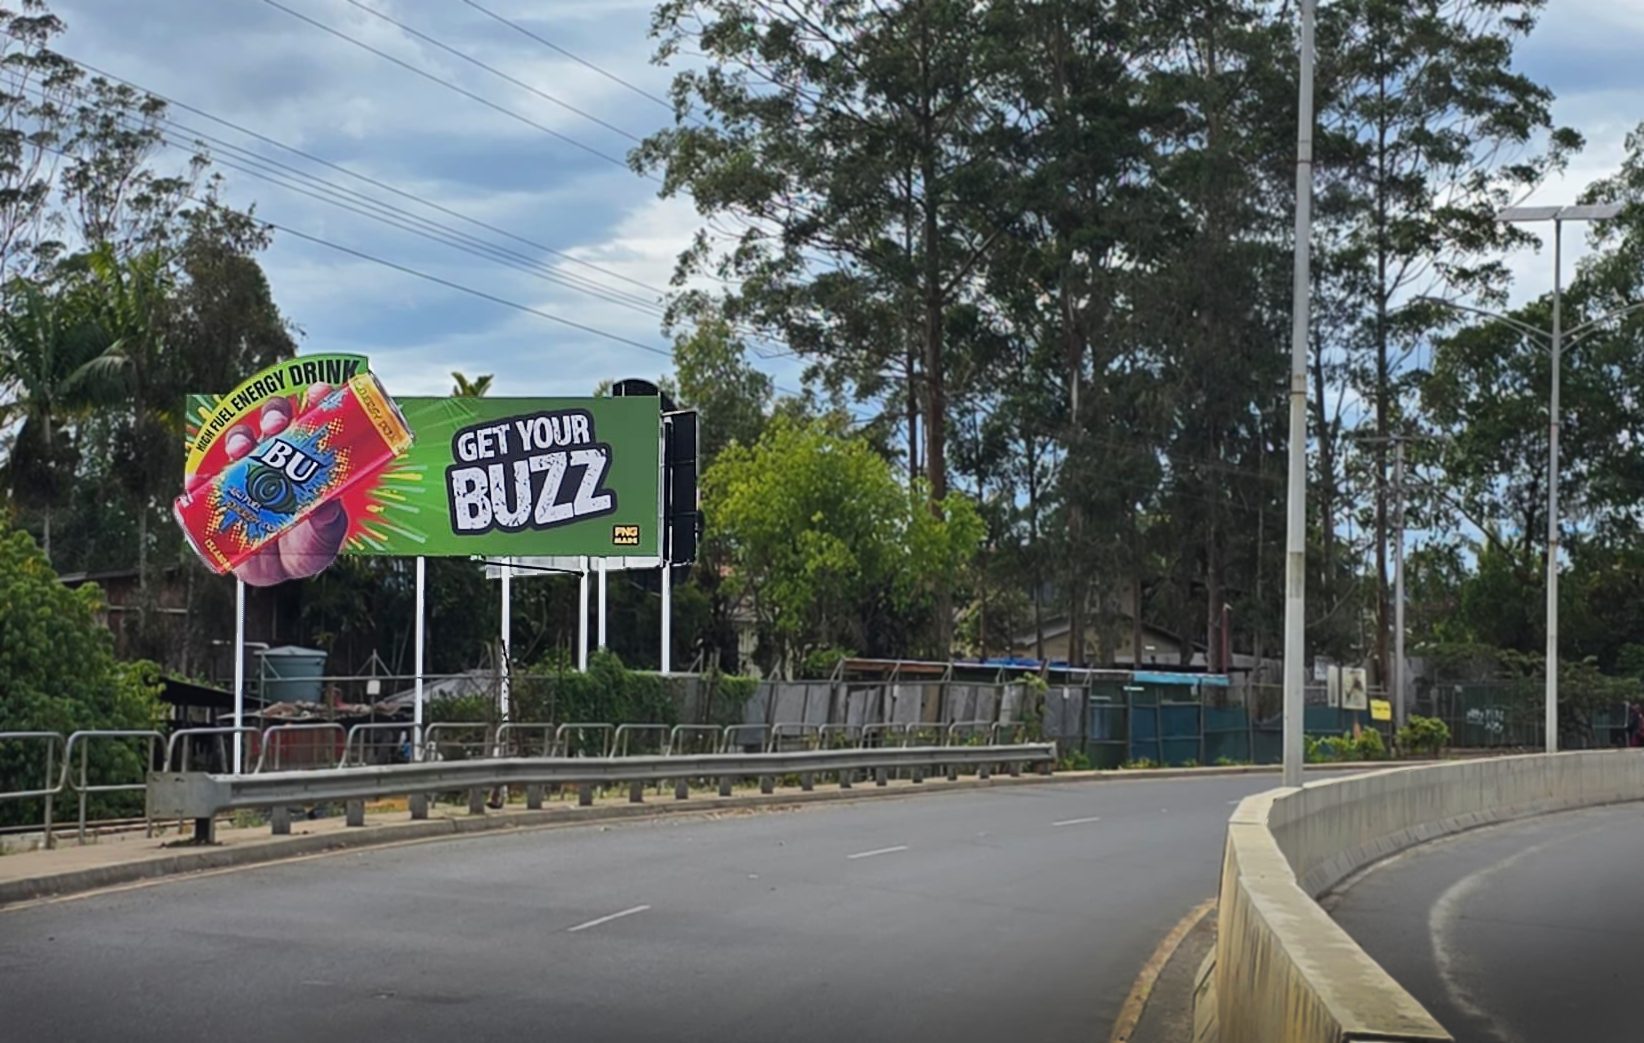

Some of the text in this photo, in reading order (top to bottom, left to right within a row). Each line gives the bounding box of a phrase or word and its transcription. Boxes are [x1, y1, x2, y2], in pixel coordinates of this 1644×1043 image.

[196, 359, 360, 453] HIGH FUEL ENERGY DRINK
[261, 441, 319, 483] BU
[457, 414, 591, 462] GET YOUR
[451, 448, 612, 530] BUZZ
[614, 526, 638, 537] PNG
